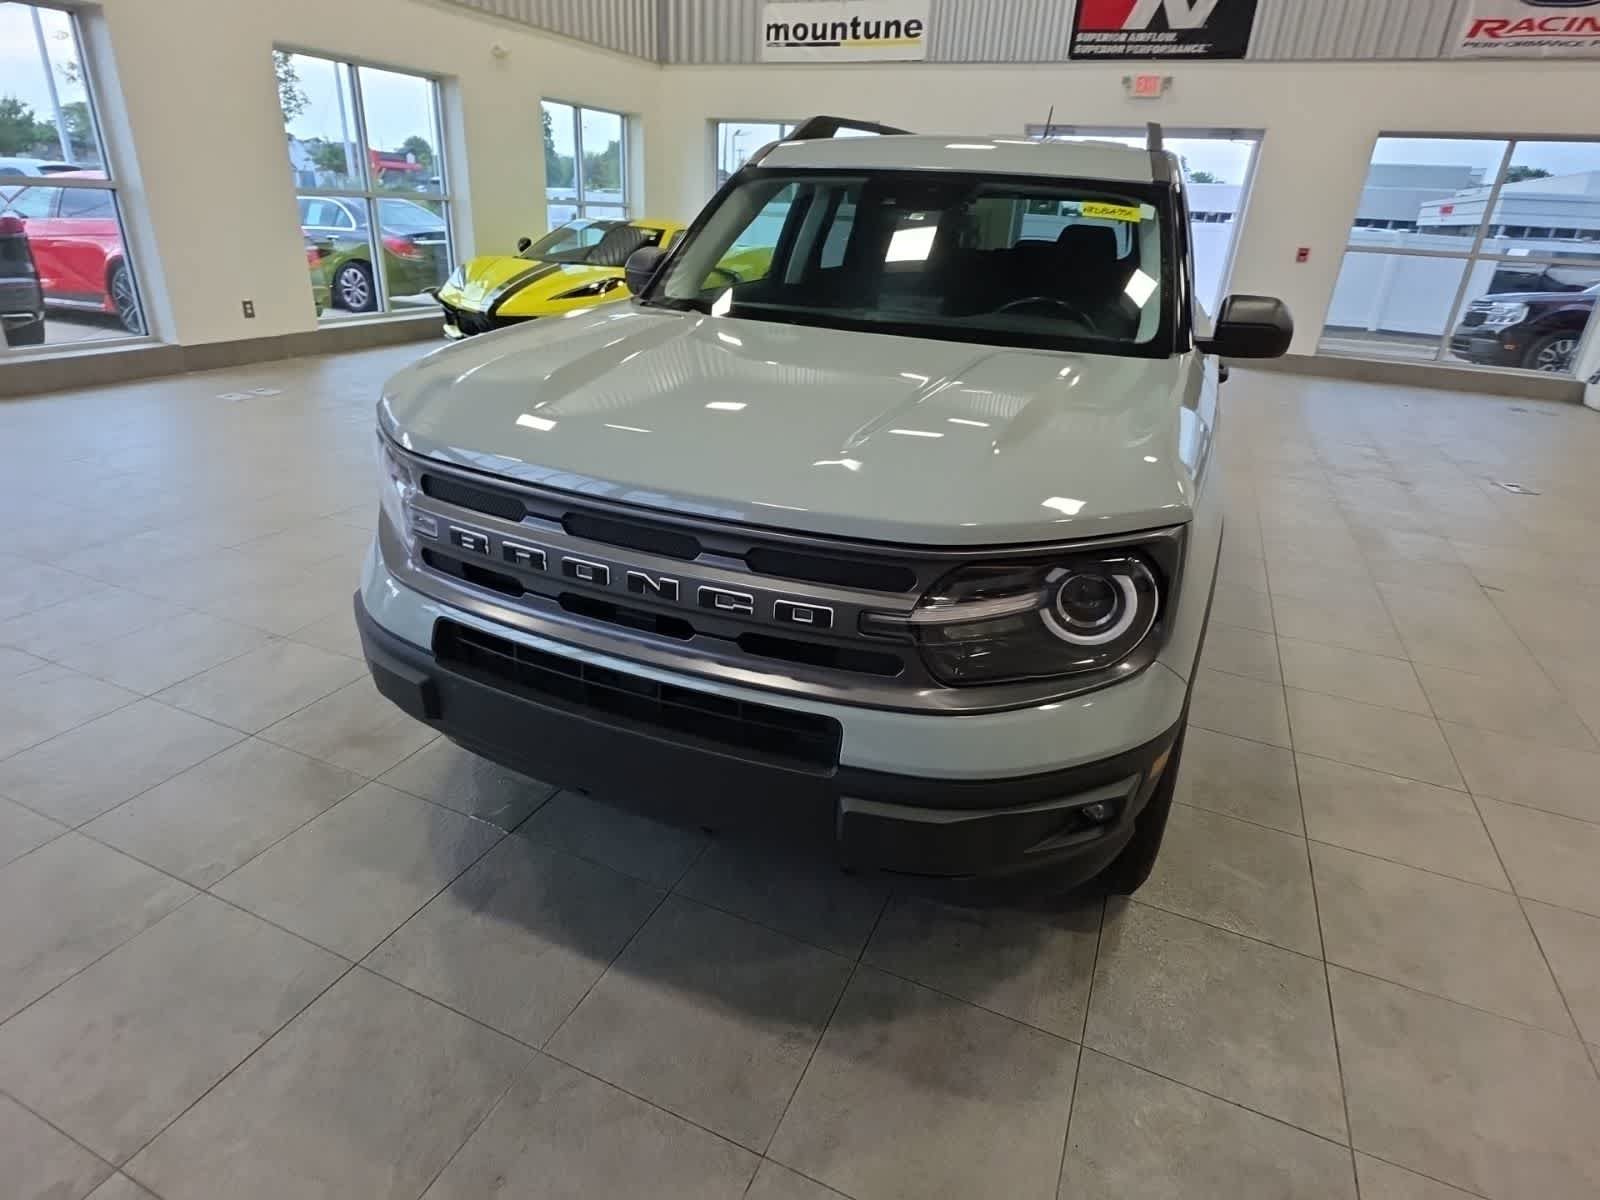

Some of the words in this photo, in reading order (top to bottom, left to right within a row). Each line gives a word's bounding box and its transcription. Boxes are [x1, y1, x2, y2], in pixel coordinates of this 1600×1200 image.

[766, 16, 923, 41] mountune
[1075, 32, 1128, 42] SUPERIOR
[1073, 44, 1125, 54] SUPERIOR
[1462, 40, 1585, 48] PERFORMANCE
[449, 525, 834, 629] BRONCO
